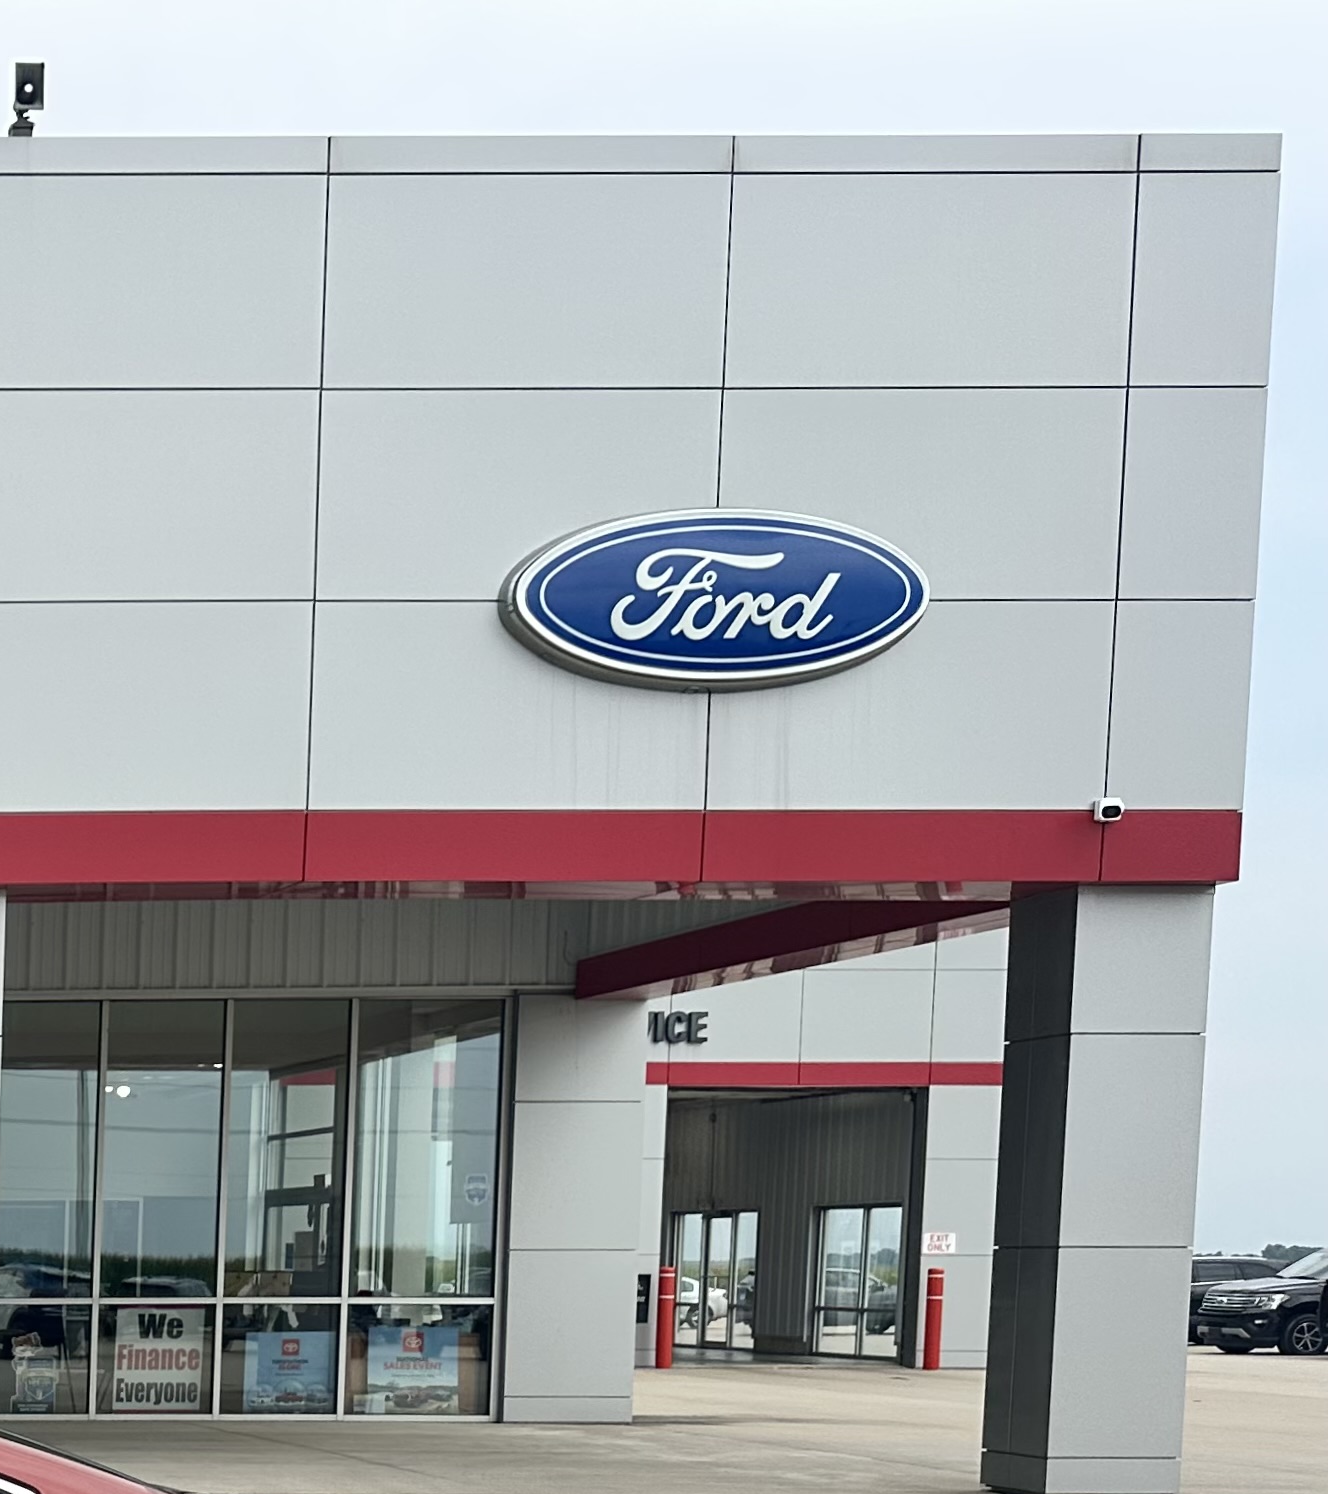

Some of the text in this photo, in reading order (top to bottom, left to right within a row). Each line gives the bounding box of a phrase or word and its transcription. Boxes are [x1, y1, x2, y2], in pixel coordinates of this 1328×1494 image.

[610, 548, 841, 641] Ford
[927, 1243, 951, 1252] ONLY
[929, 1234, 949, 1243] EXIT
[137, 1313, 184, 1339] We
[116, 1344, 200, 1371] Finance
[384, 1361, 442, 1370] SALES EVENT
[115, 1378, 198, 1405] Everyone
